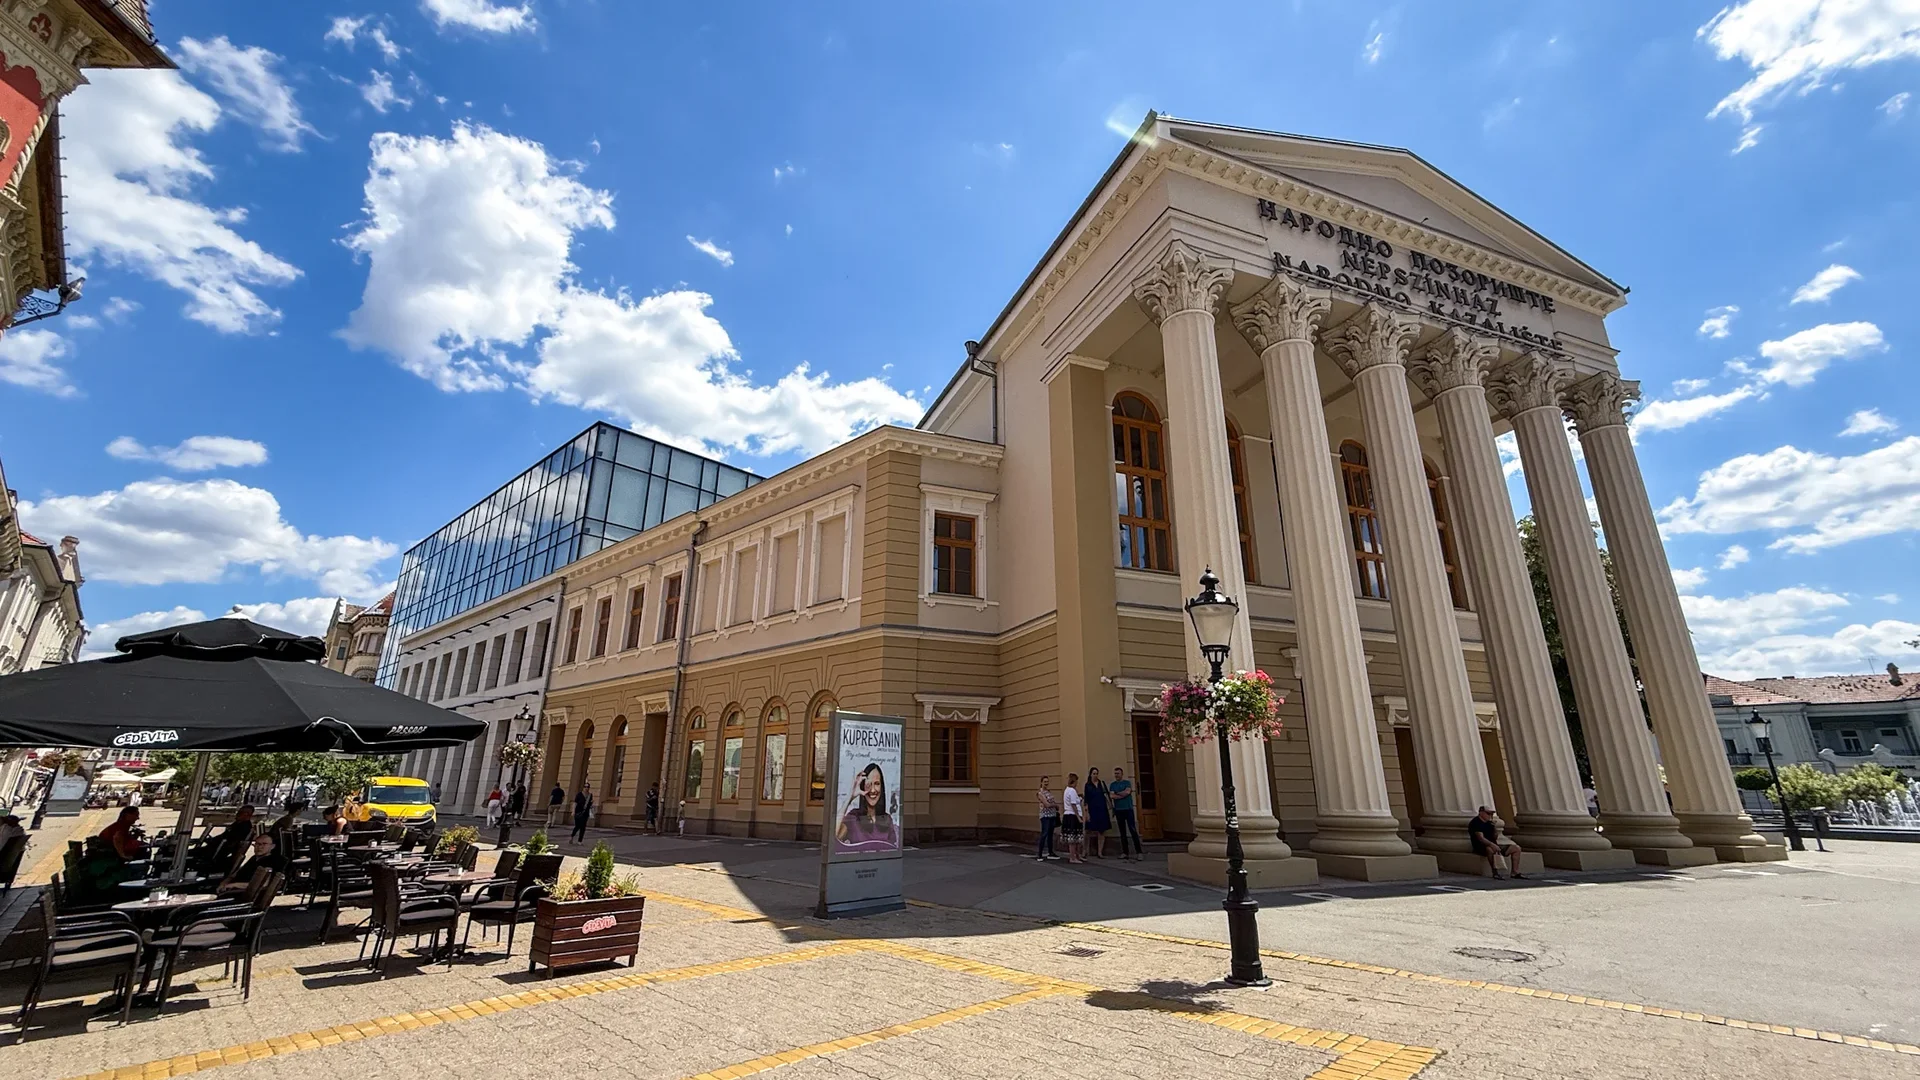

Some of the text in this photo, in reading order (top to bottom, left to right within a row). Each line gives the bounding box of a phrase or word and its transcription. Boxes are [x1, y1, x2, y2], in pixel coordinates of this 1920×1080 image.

[1258, 198, 1555, 314] НАРОДНО ПОЗОРИШТЕ
[1273, 252, 1412, 309] NARODNO
[113, 730, 179, 746] CEDEVITA
[843, 728, 900, 748] KUPREŠANIN
